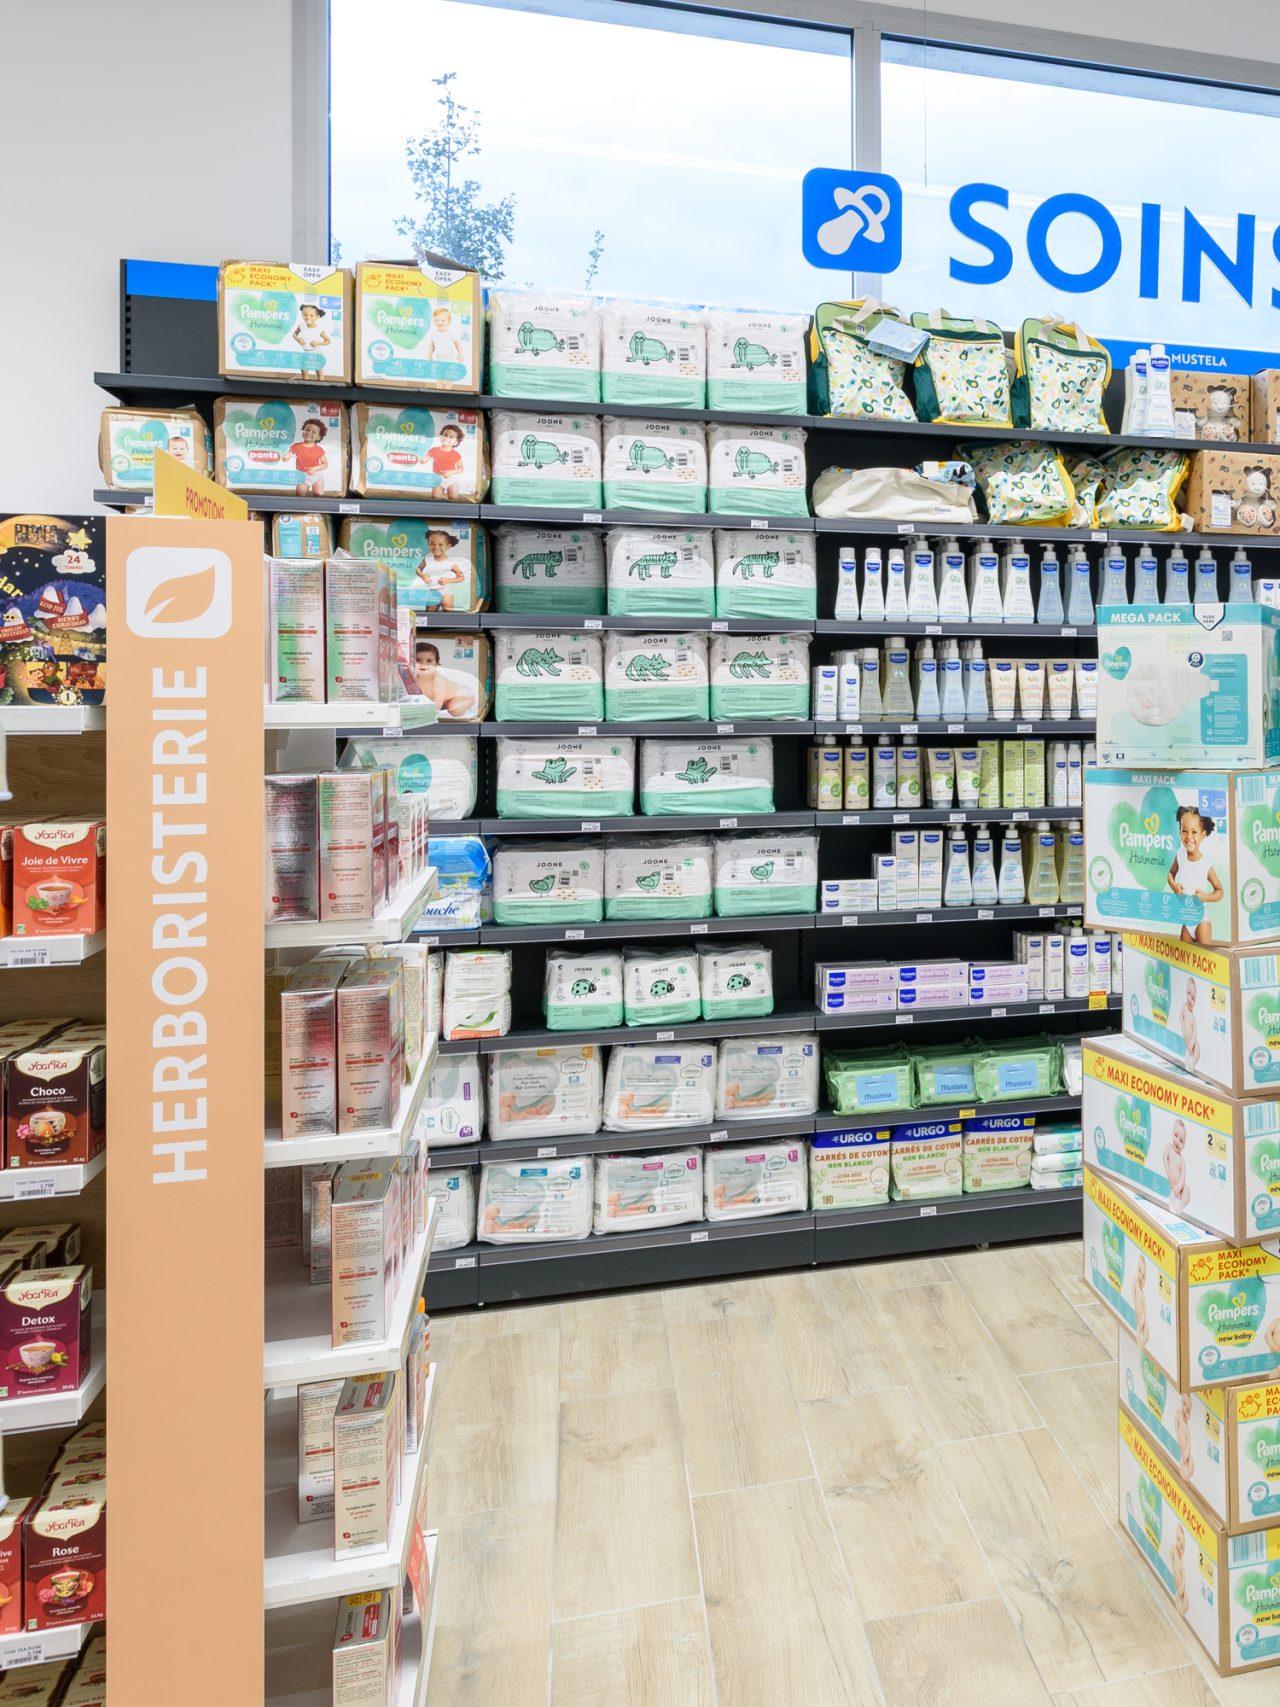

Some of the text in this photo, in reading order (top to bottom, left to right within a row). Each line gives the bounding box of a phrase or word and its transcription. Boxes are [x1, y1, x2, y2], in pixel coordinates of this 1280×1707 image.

[250, 266, 270, 274] MAXI
[250, 273, 292, 282] ECONOMY
[240, 304, 290, 322] Pampers
[1171, 353, 1227, 367] MUSTELA
[645, 423, 671, 431] JOONE
[235, 423, 288, 444] Pampers
[249, 451, 279, 462] pants
[67, 555, 80, 564] 24
[1110, 612, 1181, 623] MEGA PACK
[1131, 774, 1176, 786] MAXI PACK
[1201, 795, 1209, 809] 5
[1119, 822, 1174, 852] Pampers
[21, 856, 88, 866] Joie de Vivre
[536, 860, 563, 868] JOONE
[1129, 852, 1166, 867] Harmonie
[151, 666, 208, 1184] HERBORISTERIE
[1138, 934, 1155, 952] MAXI
[1155, 936, 1190, 967] ECONOMY
[941, 1082, 967, 1092] Mustela
[1107, 1065, 1130, 1087] MAXI
[1130, 1076, 1180, 1107] ECONOMY
[30, 1087, 66, 1097] Choco
[864, 1090, 892, 1101] Mustela
[989, 1118, 1020, 1128] URGO
[913, 1125, 945, 1137] URGO
[839, 1132, 873, 1144] URGO
[966, 1135, 1033, 1146] CARRÉS DE COTON
[815, 1148, 890, 1162] CARRÉS DE COTON
[822, 1195, 834, 1205] 180
[1098, 1187, 1112, 1210] MAXI
[1112, 1202, 1143, 1242] ECONOMY
[1217, 1250, 1242, 1261] MAXI
[1218, 1256, 1268, 1271] ECONOMY
[1208, 1303, 1259, 1324] Pampers
[21, 1315, 55, 1326] Detox
[1218, 1332, 1252, 1343] new baby
[1133, 1437, 1150, 1463] MAXI
[1148, 1457, 1182, 1505] ECONOMY
[1266, 1470, 1280, 1479] new
[52, 1546, 79, 1557] Rose
[1256, 1615, 1272, 1623] new
